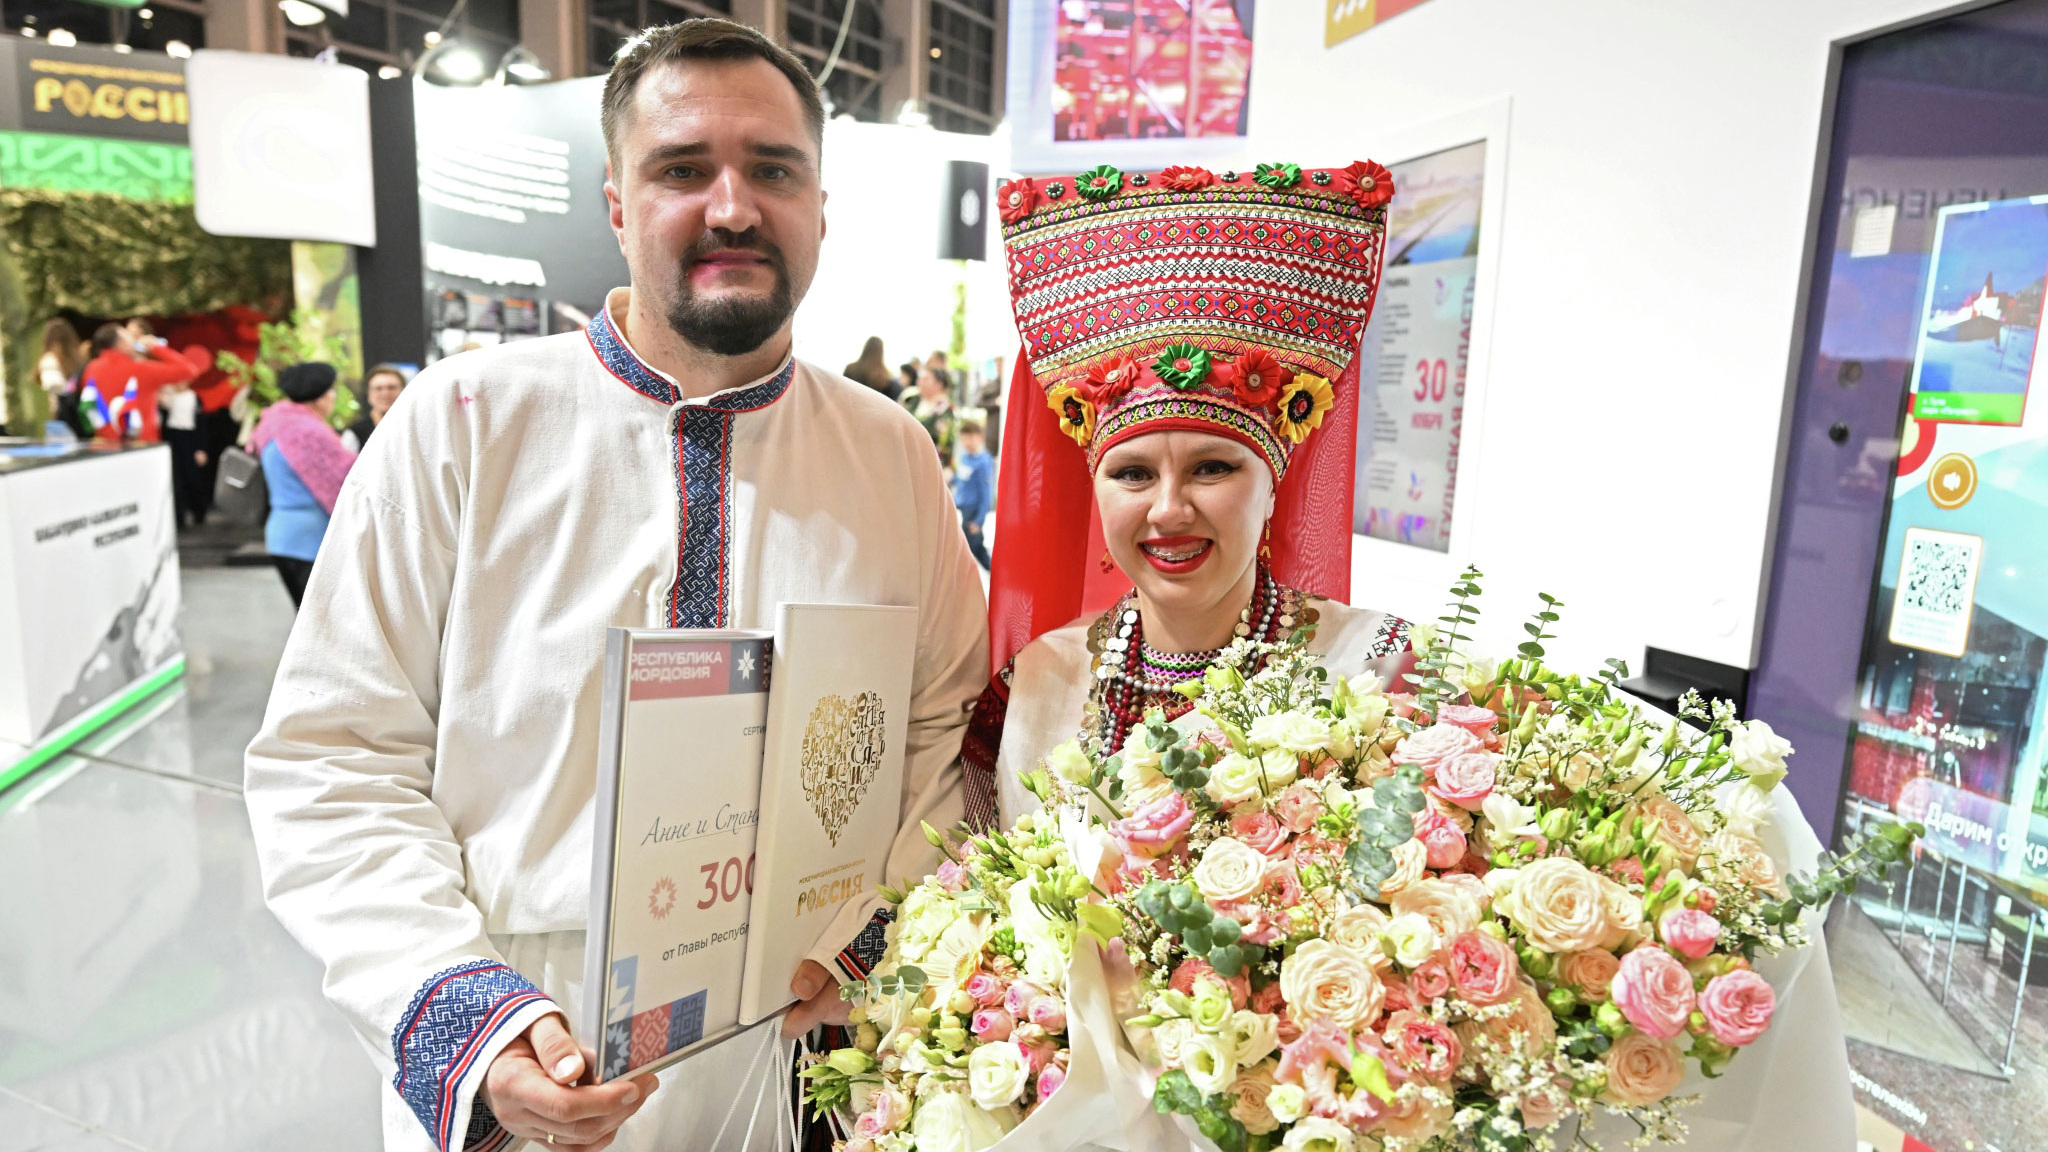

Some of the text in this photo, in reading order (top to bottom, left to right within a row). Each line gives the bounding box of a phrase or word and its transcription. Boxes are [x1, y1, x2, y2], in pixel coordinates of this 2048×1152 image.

[1414, 357, 1448, 402] 30
[630, 666, 711, 683] МОРДОВИЯ
[631, 651, 723, 667] РЕСПУБЛИКА
[640, 815, 691, 846] Анне
[696, 819, 708, 835] и
[1923, 801, 2048, 869] Дарим окр
[795, 872, 865, 918] РОССИЯ
[662, 948, 675, 961] от
[677, 937, 708, 957] Главы
[1848, 1066, 1929, 1127] остелеком
